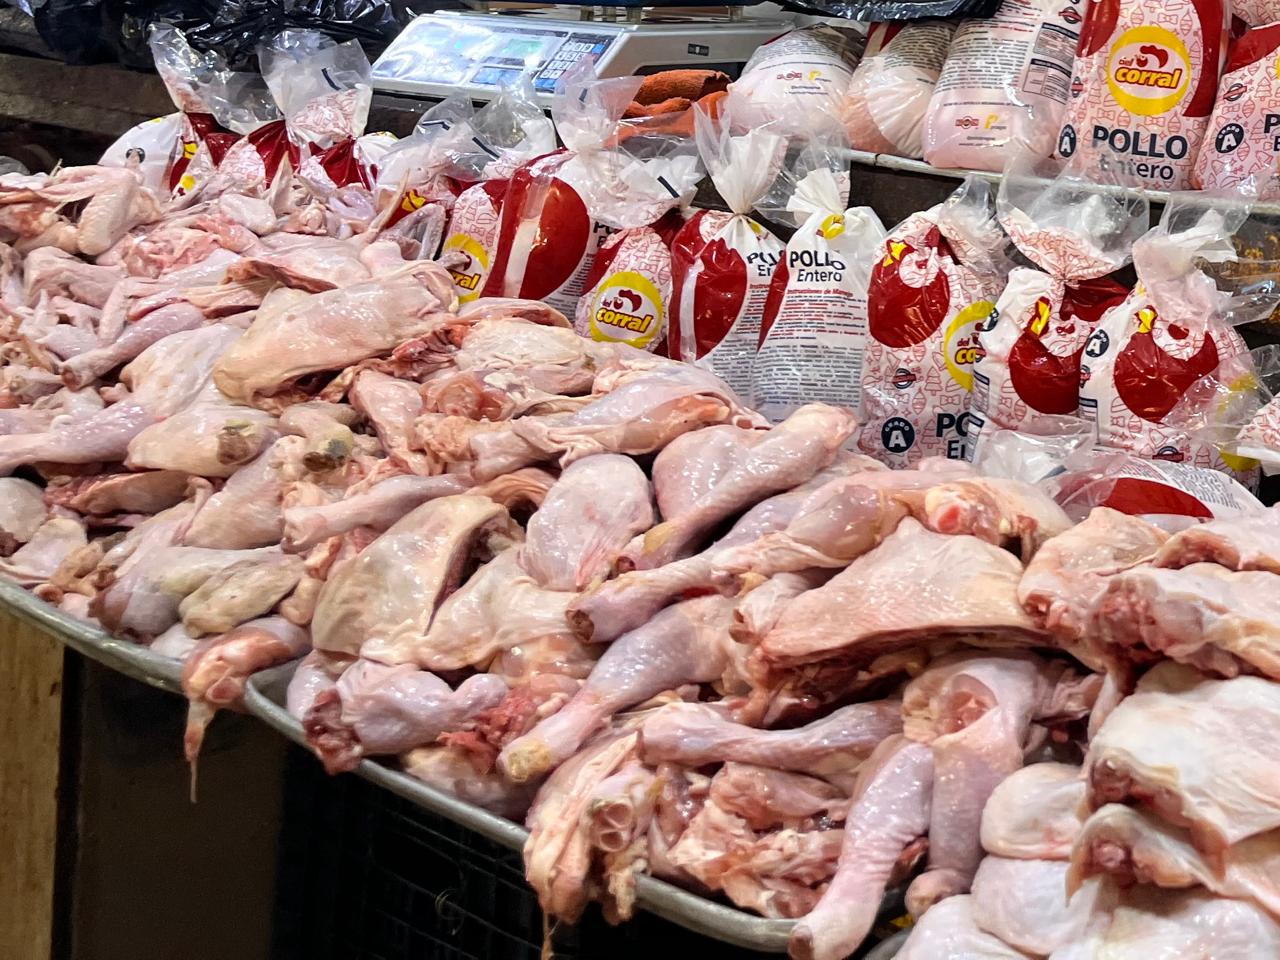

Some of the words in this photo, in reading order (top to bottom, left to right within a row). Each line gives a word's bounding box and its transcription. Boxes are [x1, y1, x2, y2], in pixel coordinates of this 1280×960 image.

[1114, 67, 1183, 89] corral
[1093, 125, 1188, 160] POLLO
[789, 250, 846, 271] POLLO
[797, 268, 843, 283] Entero
[596, 306, 654, 334] corral
[885, 420, 910, 432] GRADO
[888, 430, 907, 448] A
